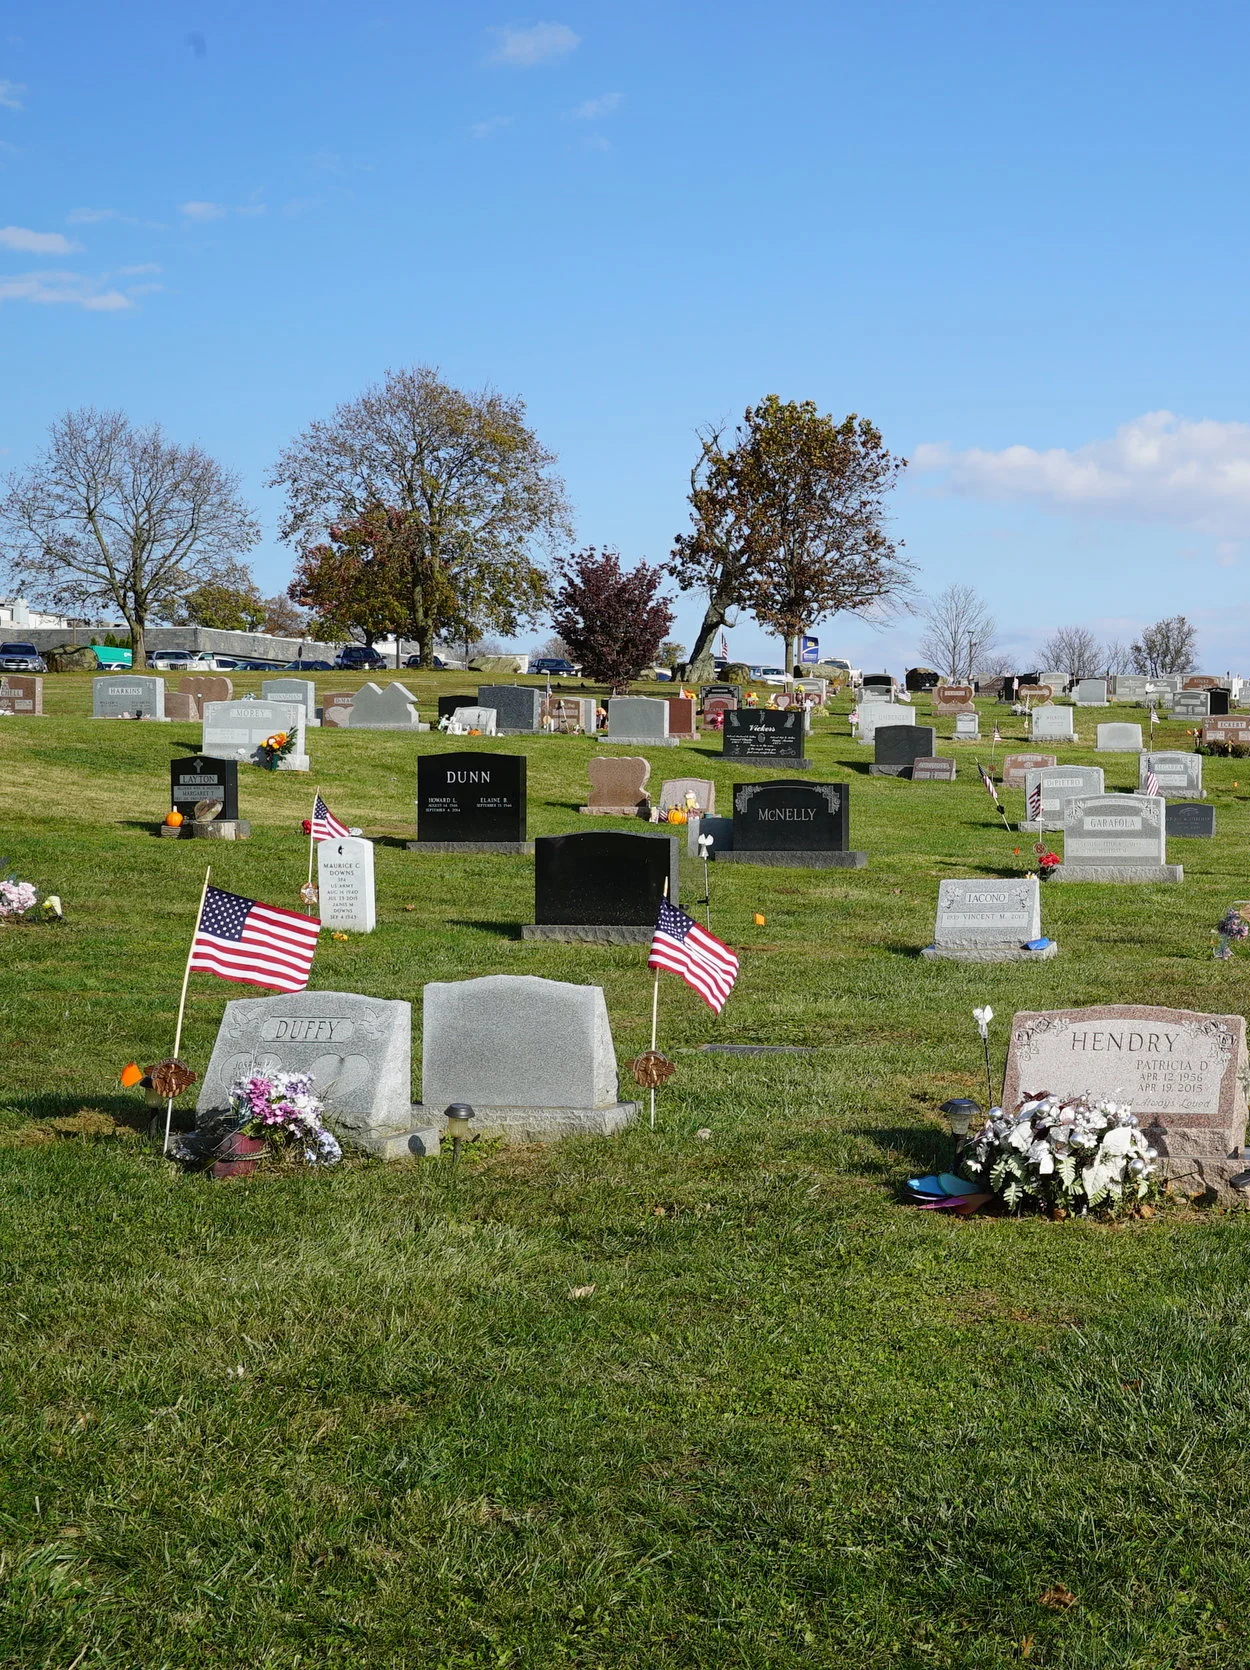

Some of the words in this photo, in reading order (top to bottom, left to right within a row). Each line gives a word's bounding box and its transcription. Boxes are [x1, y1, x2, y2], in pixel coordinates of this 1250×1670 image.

[110, 688, 141, 696] HARKINS
[236, 708, 265, 718] MOREY
[749, 723, 776, 732] Vickers
[1220, 721, 1244, 729] ECKERT
[182, 775, 215, 784] LAYTON
[446, 771, 490, 784] DUNN
[758, 808, 817, 821] McNELLY
[1090, 818, 1135, 828] GARAFOLA
[967, 893, 1006, 903] IACONO
[275, 1020, 341, 1040] DUFFY
[1071, 1031, 1180, 1052] HENDRY
[1136, 1059, 1192, 1071] PATRICIA
[1199, 1060, 1209, 1071] D
[1179, 1072, 1203, 1082] 1956
[1177, 1083, 1203, 1093] 2015
[1135, 1098, 1175, 1110] Always
[1179, 1099, 1211, 1109] Loved
